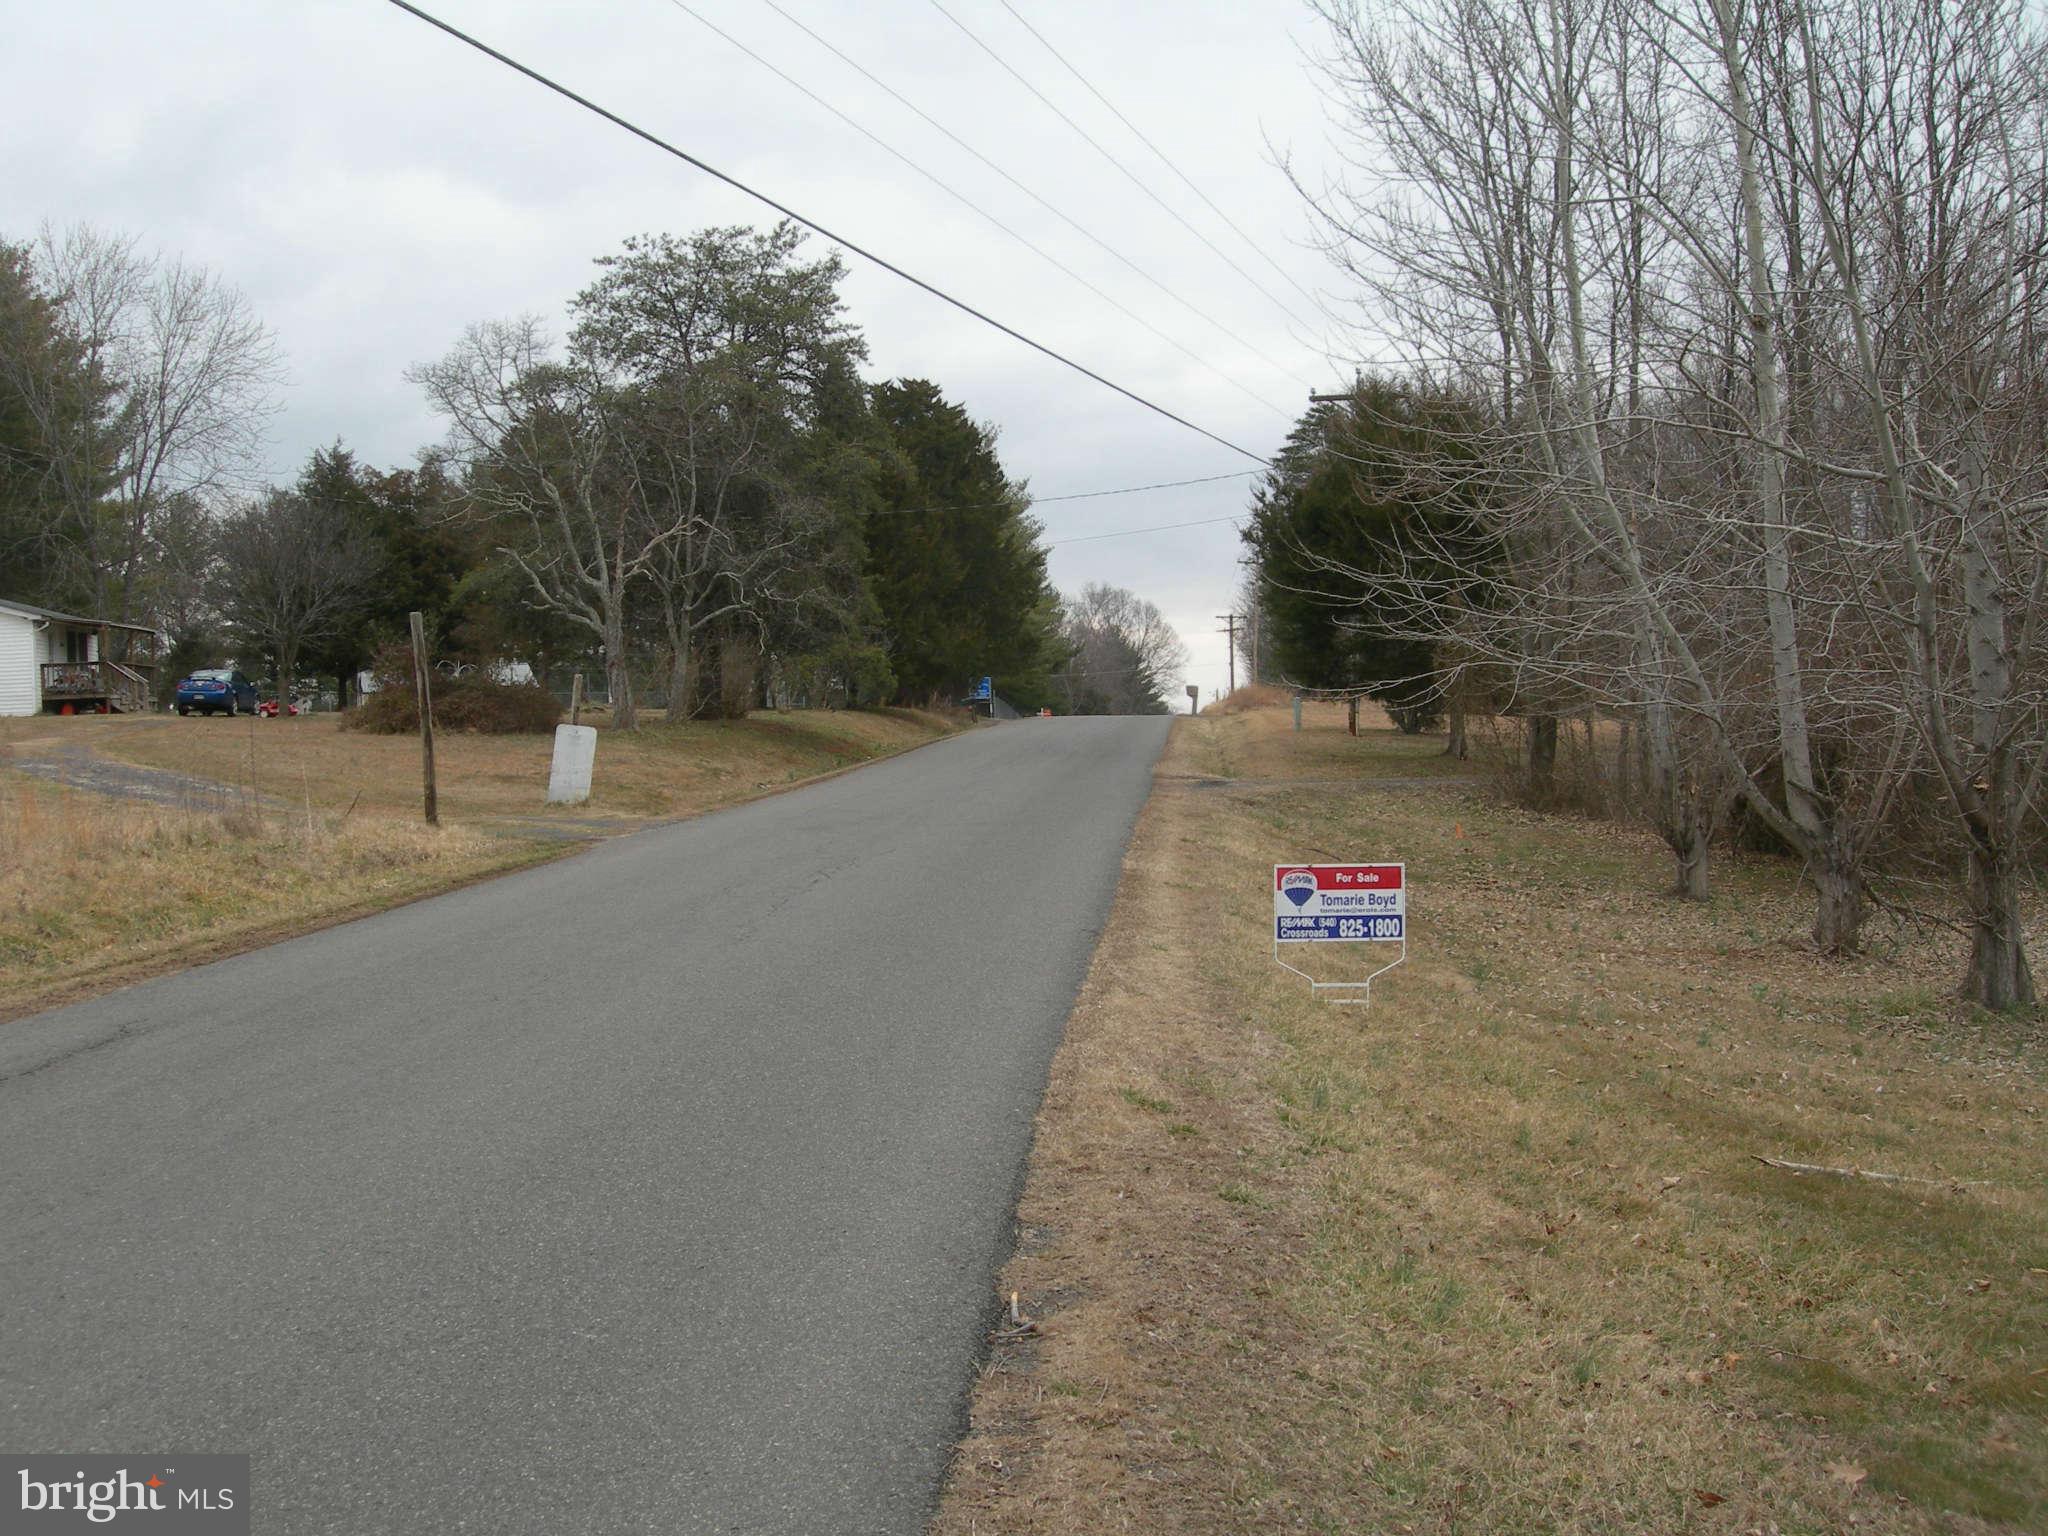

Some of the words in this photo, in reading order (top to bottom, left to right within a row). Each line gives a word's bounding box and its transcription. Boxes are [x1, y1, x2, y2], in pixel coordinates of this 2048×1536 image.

[1336, 873, 1353, 883] For
[1356, 872, 1379, 883] Sale
[1320, 894, 1365, 906] Tomarie
[1368, 893, 1397, 908] Boyd
[1280, 918, 1316, 928] RE/MAX
[1318, 917, 1337, 928] (540)
[1339, 918, 1400, 937] 825-1800
[1280, 928, 1329, 938] Crossroads
